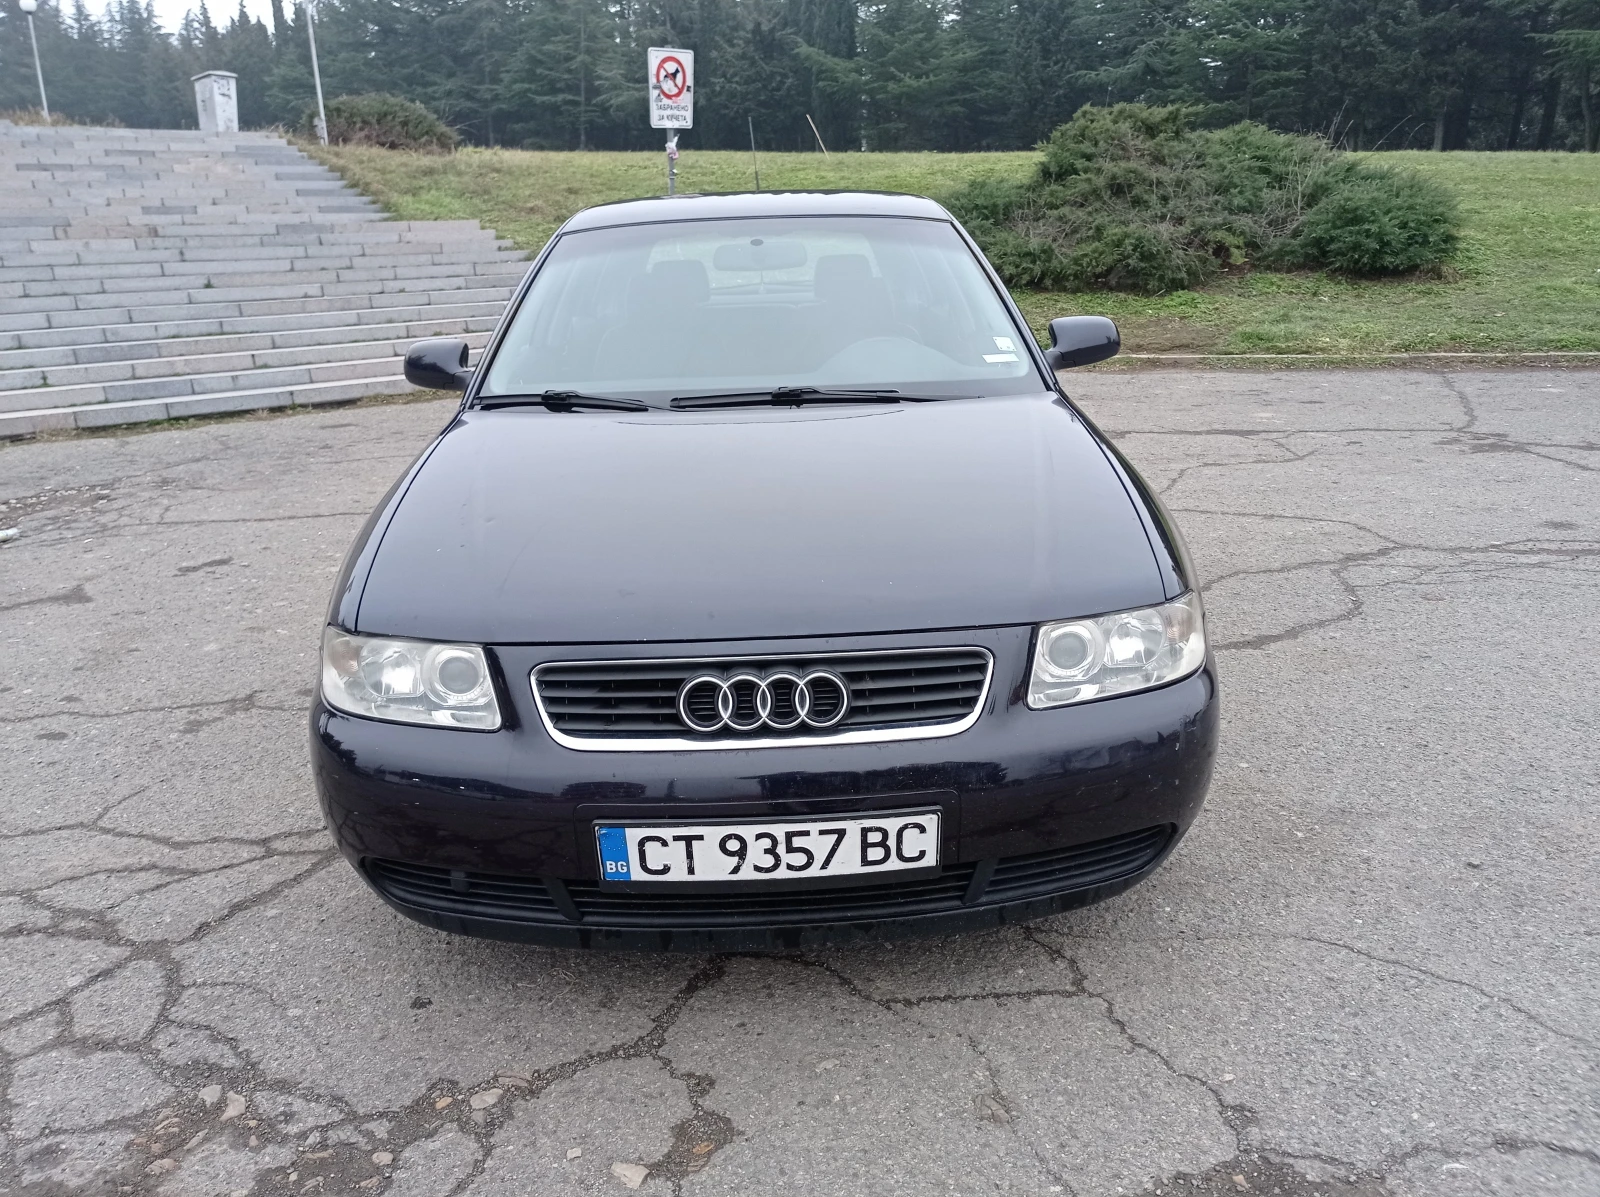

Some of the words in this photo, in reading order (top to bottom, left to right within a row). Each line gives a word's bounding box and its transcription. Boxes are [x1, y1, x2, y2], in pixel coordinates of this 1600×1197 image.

[655, 104, 689, 112] ЗАБРАНЕНО
[657, 114, 664, 122] ЗА
[637, 834, 704, 875] CT
[718, 828, 847, 875] 9357
[860, 822, 927, 867] BC
[606, 861, 628, 873] BG
